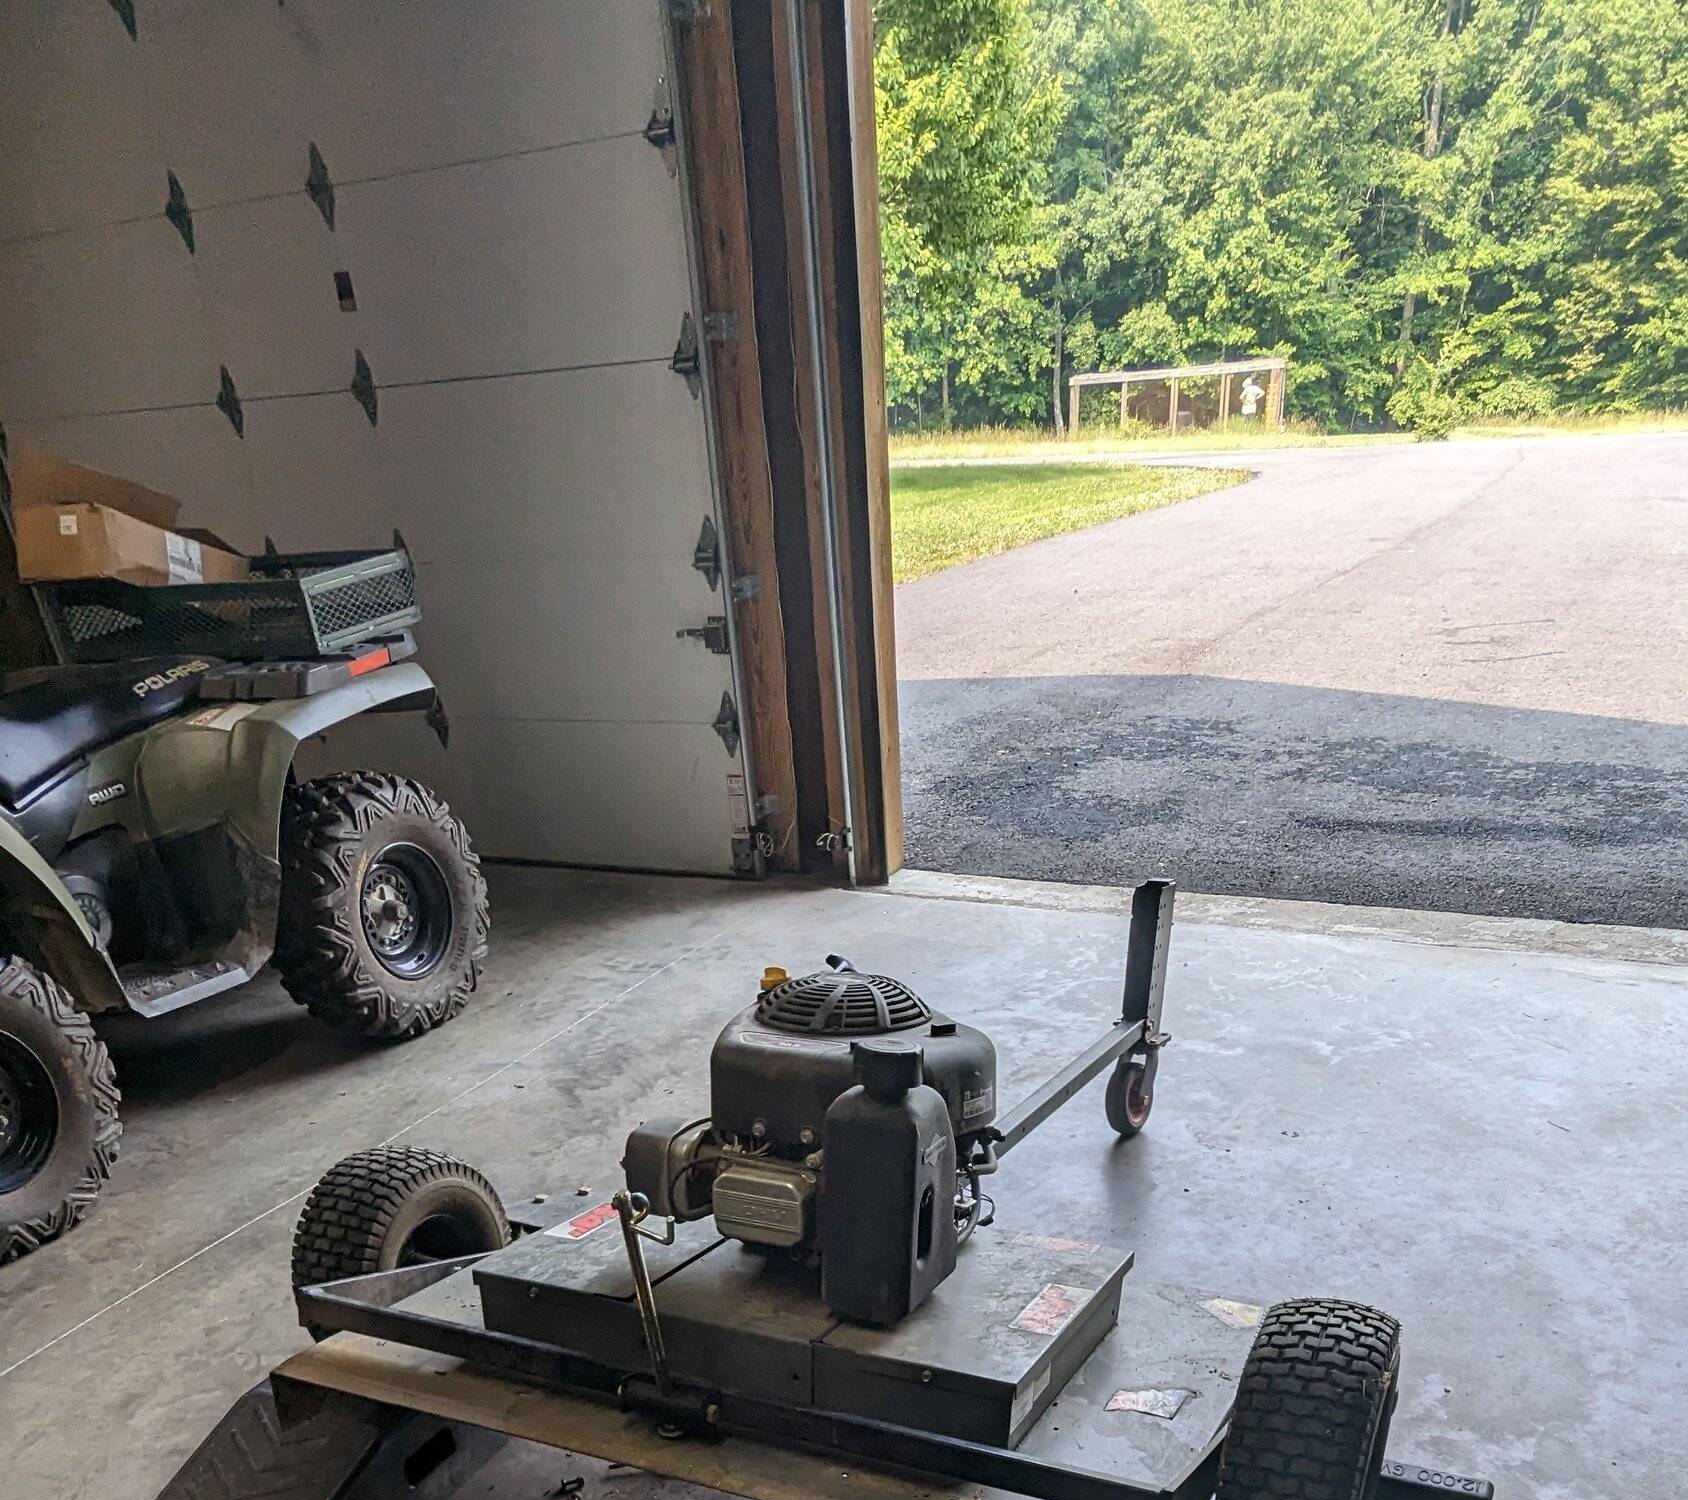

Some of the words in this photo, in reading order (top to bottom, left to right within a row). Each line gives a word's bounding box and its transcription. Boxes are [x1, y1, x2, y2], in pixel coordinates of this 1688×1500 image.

[132, 660, 210, 698] POLARIS
[88, 783, 126, 806] AWD
[1417, 1470, 1482, 1493] 12,000
